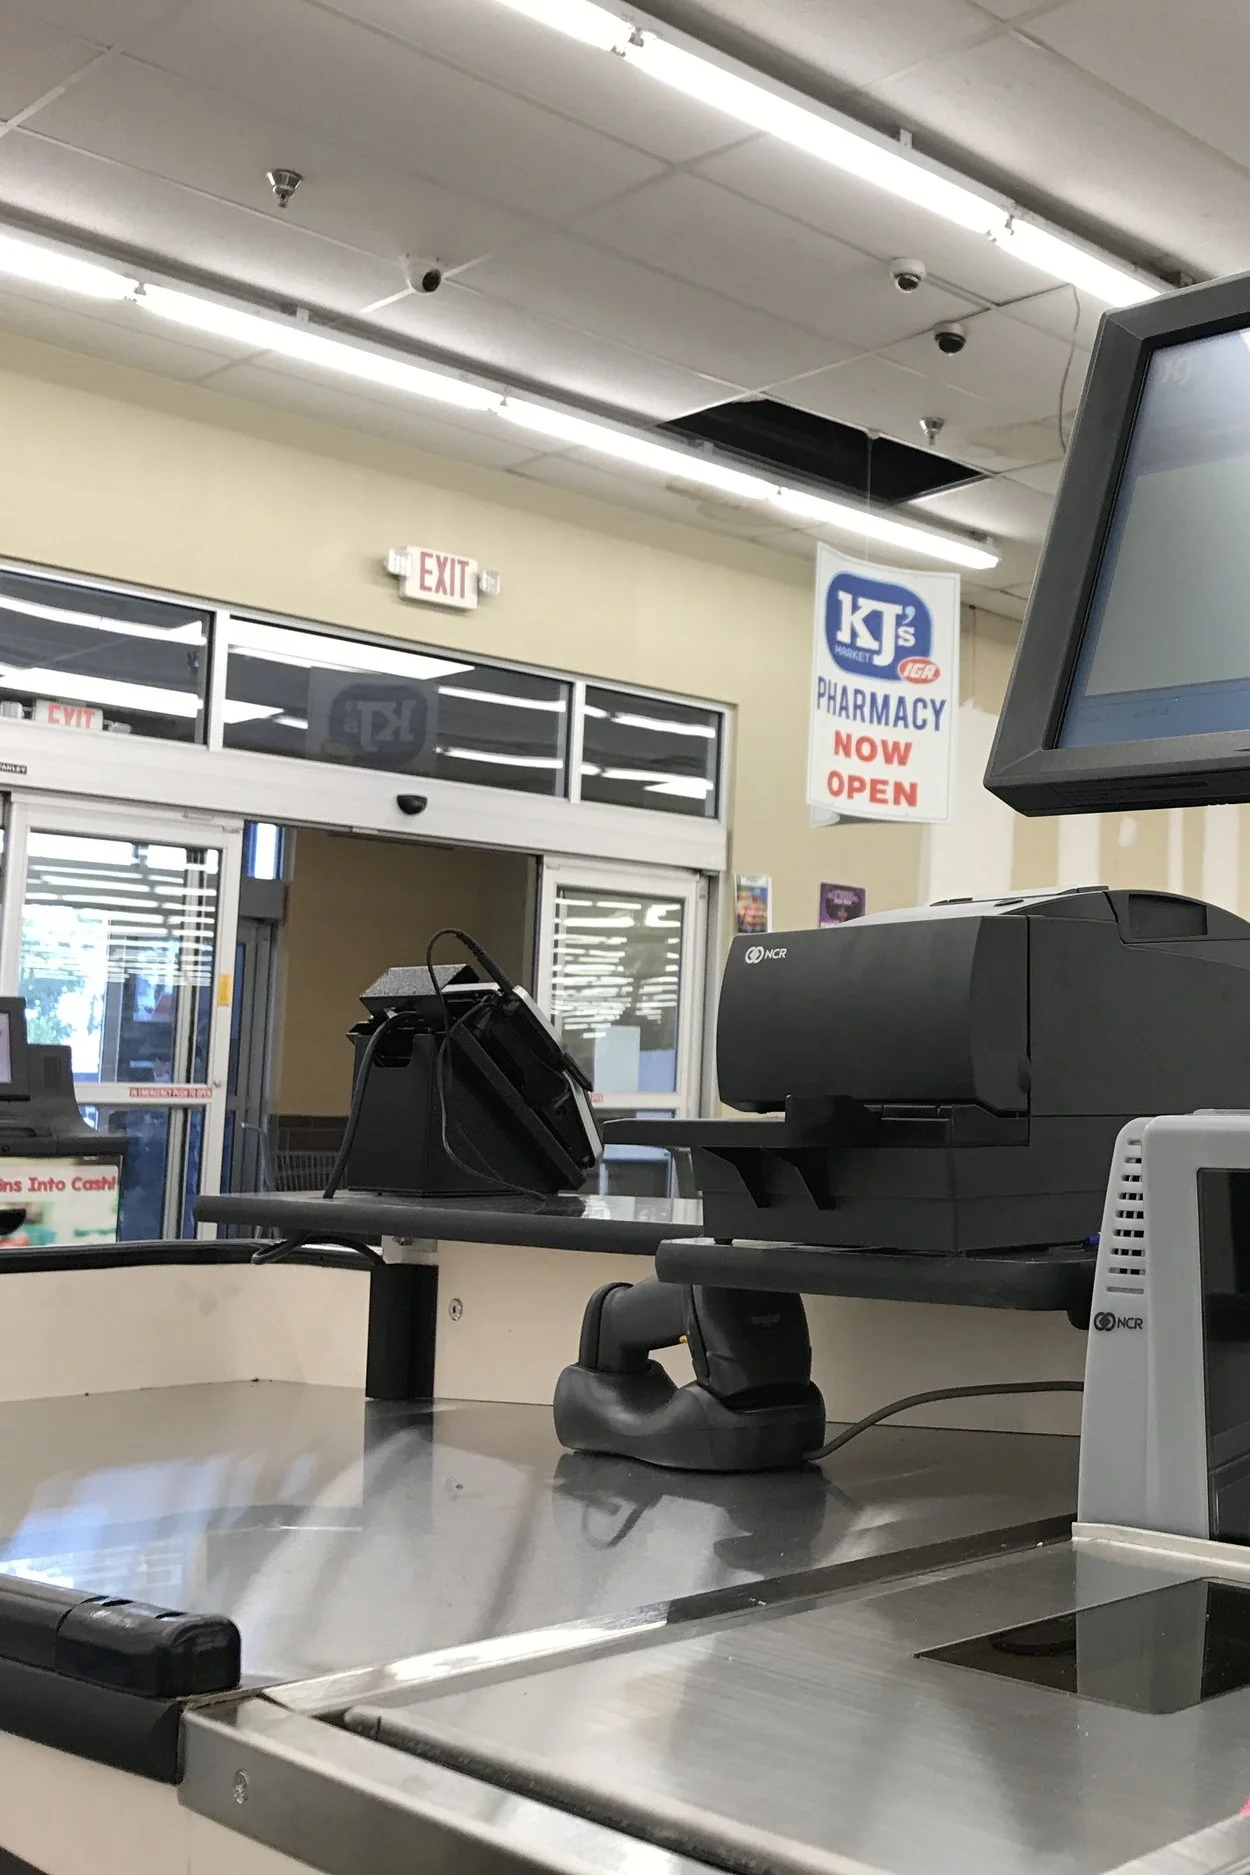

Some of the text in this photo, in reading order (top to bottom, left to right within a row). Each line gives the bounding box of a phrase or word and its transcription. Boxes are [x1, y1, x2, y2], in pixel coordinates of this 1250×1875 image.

[420, 551, 470, 599] EXIT
[903, 661, 936, 680] IGA
[817, 676, 947, 732] PHARMACY
[834, 730, 913, 767] NOW
[827, 770, 918, 808] OPEN
[764, 948, 787, 960] NCR
[28, 1176, 66, 1193] Into
[71, 1175, 117, 1192] Cash!
[1117, 1317, 1143, 1330] NCR
